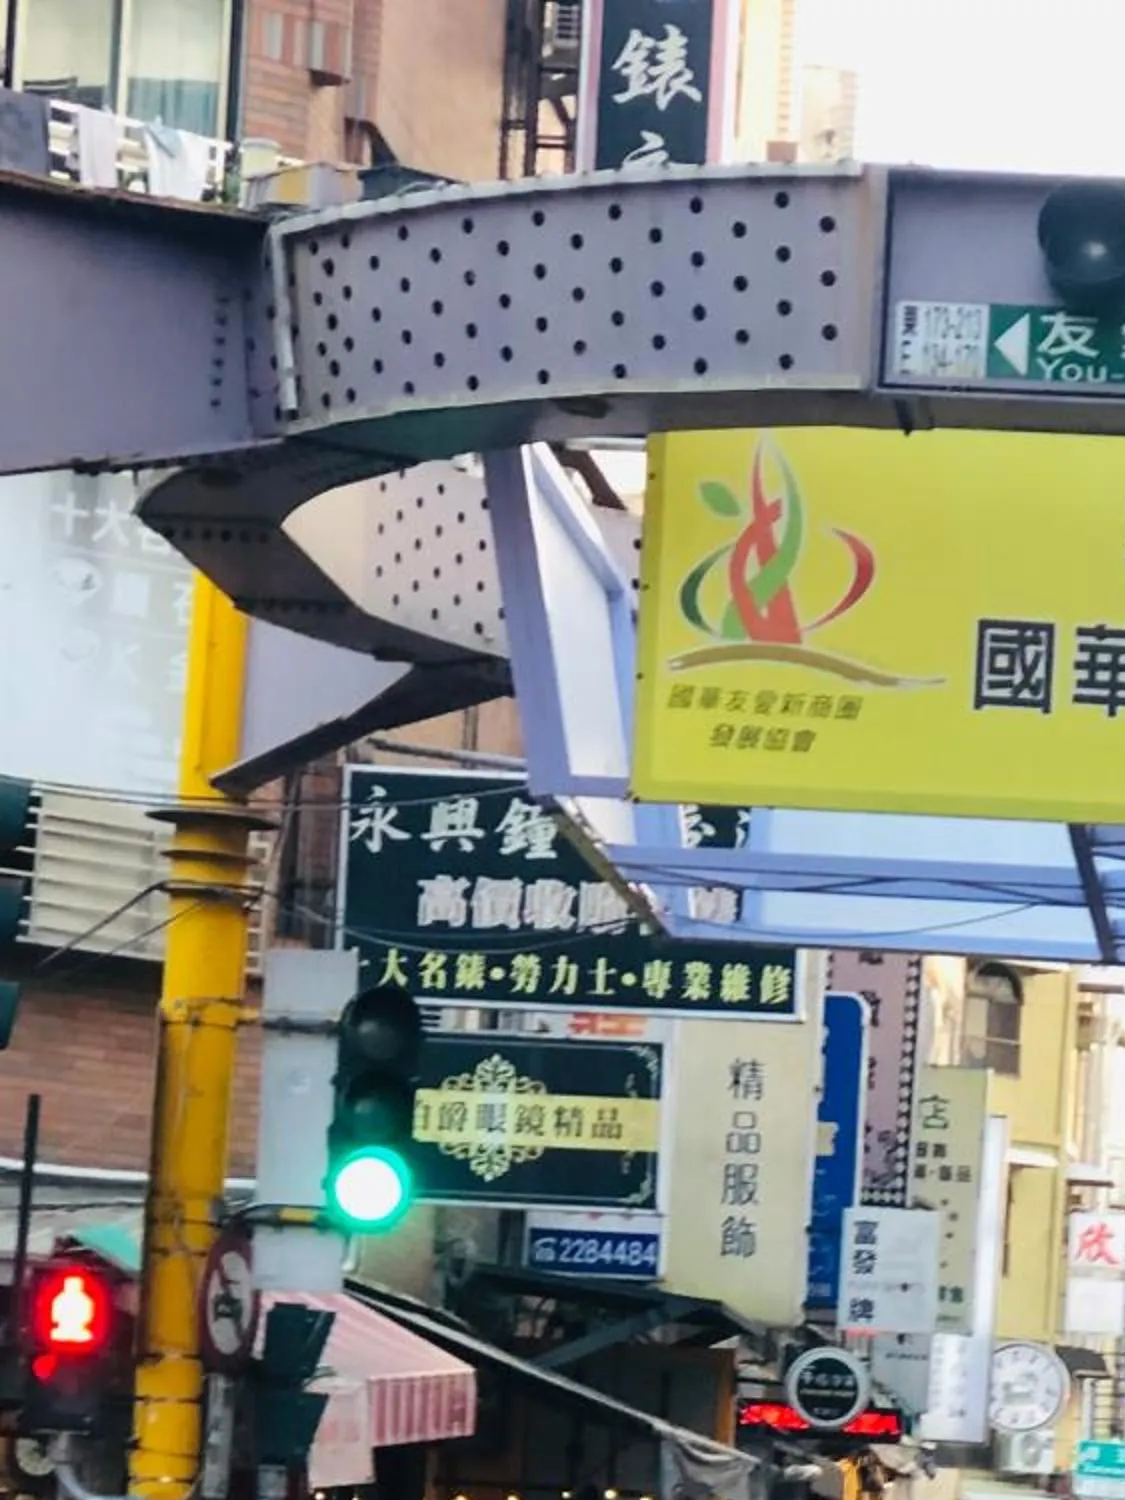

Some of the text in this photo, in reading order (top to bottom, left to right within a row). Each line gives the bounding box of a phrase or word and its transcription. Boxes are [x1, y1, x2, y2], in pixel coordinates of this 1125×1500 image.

[668, 683, 863, 720] 國華友愛新商圈
[720, 1056, 767, 1260] 精品服飾
